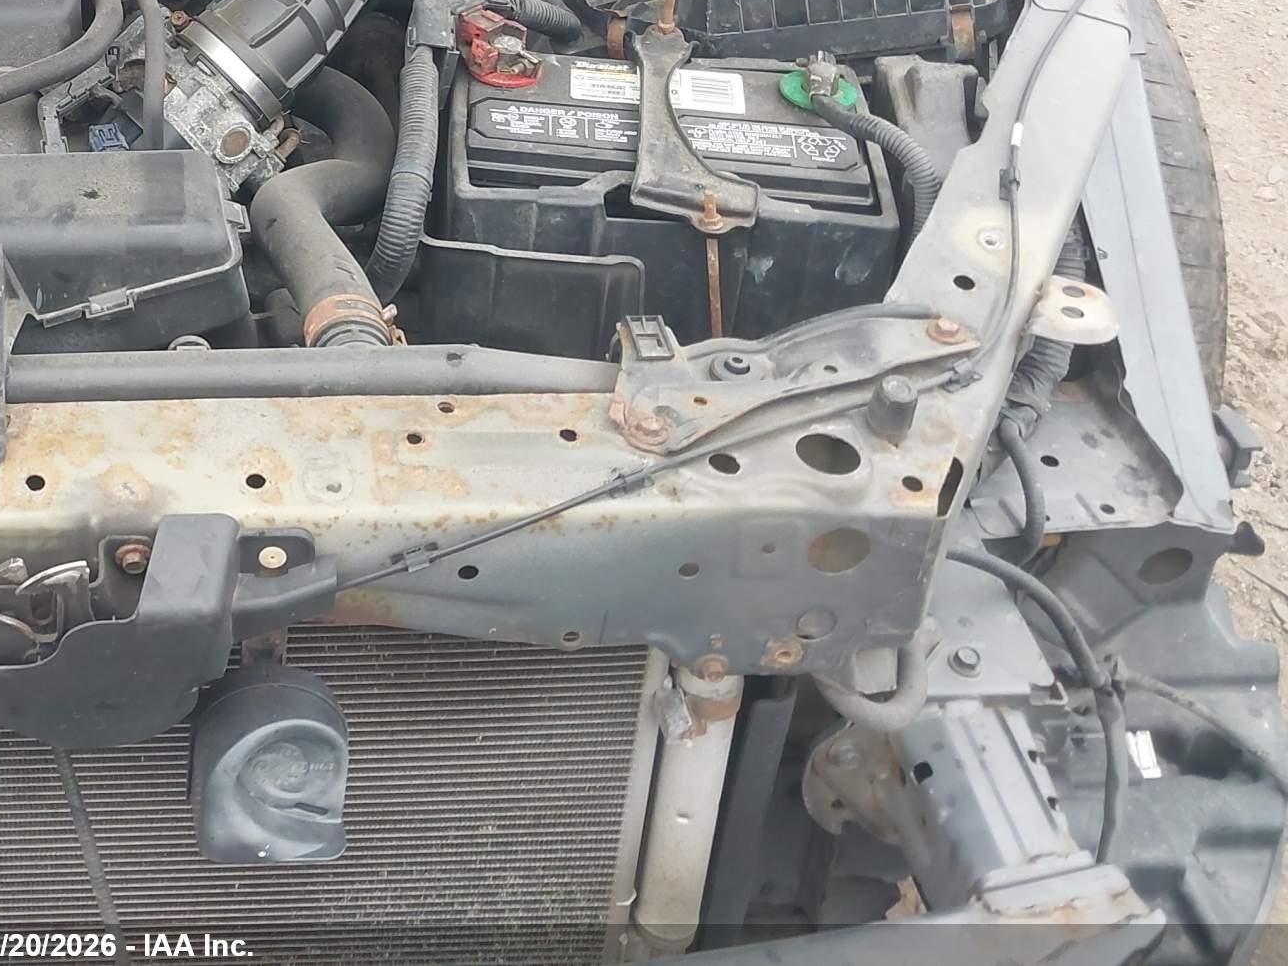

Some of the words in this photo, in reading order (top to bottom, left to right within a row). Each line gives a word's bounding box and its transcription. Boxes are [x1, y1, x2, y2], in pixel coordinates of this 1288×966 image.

[574, 60, 630, 72] Duralast
[519, 105, 566, 117] DANGER
[577, 110, 619, 120] POISON
